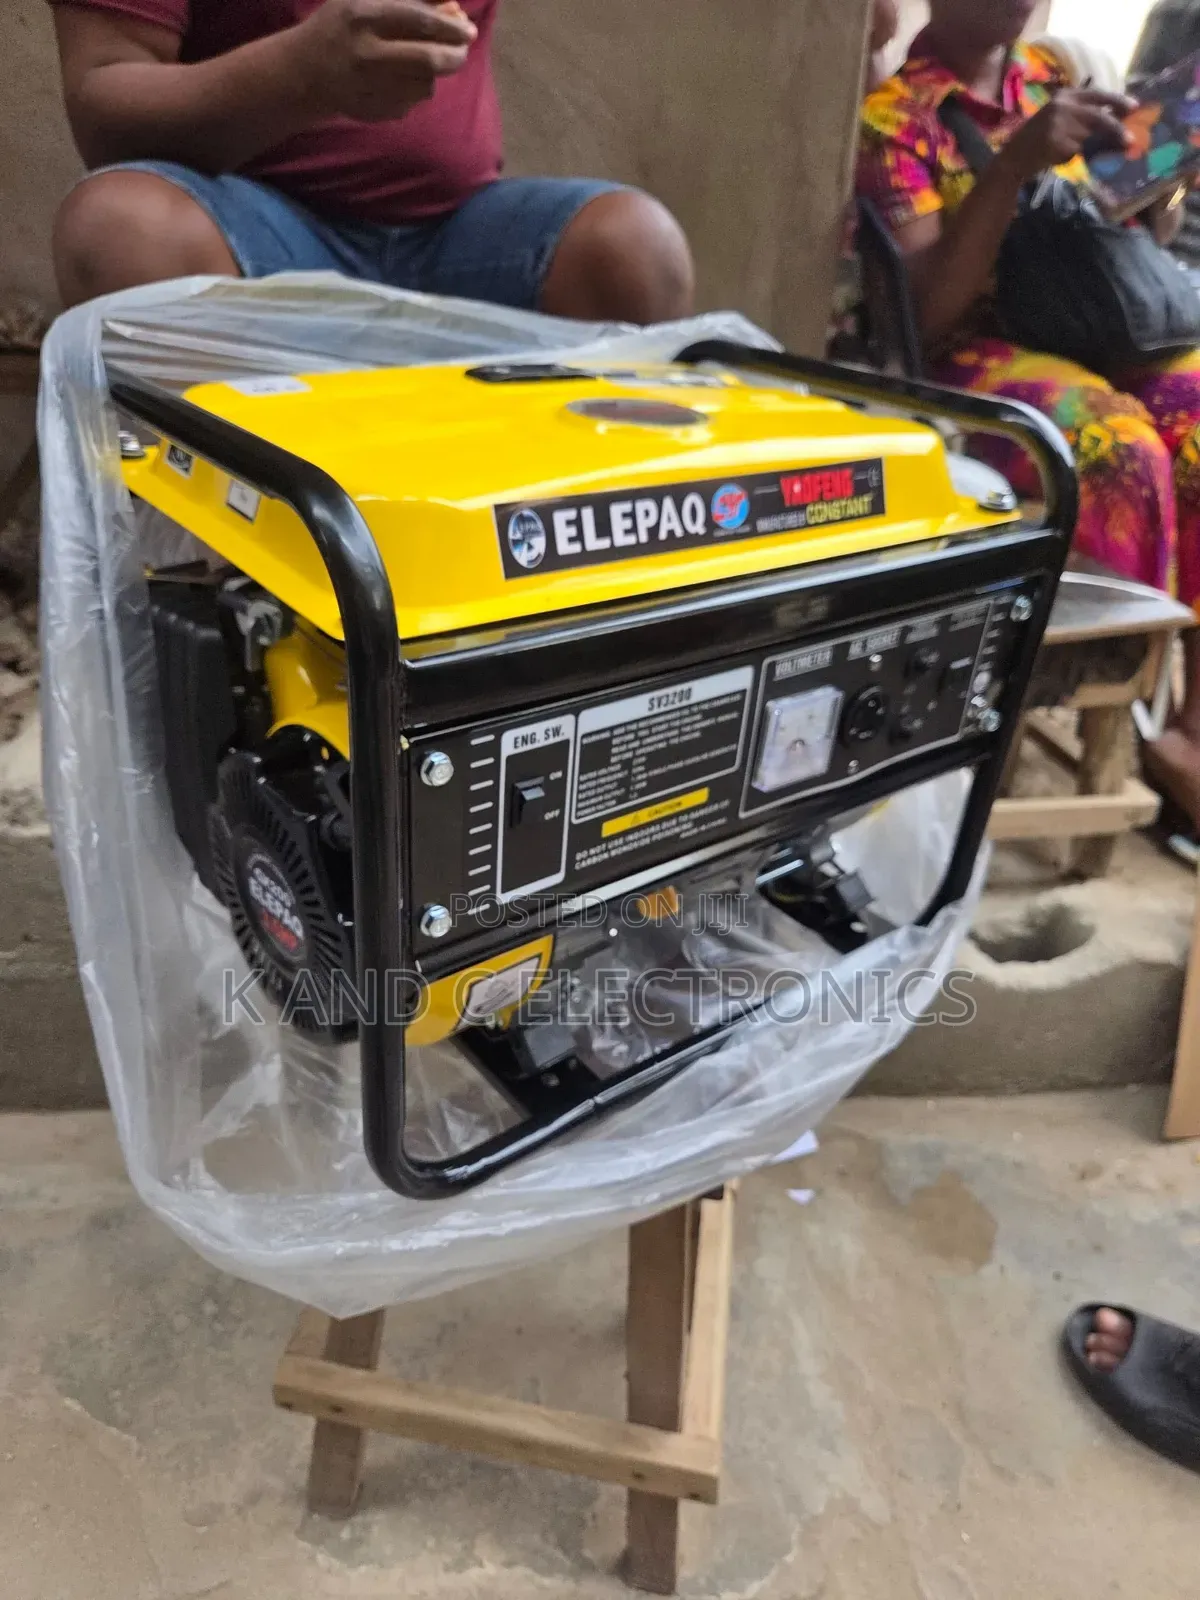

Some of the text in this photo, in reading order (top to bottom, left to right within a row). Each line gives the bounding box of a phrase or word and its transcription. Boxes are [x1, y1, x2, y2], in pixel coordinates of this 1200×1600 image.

[552, 491, 707, 556] ELEPAQ
[513, 724, 565, 749] ENG. SW.
